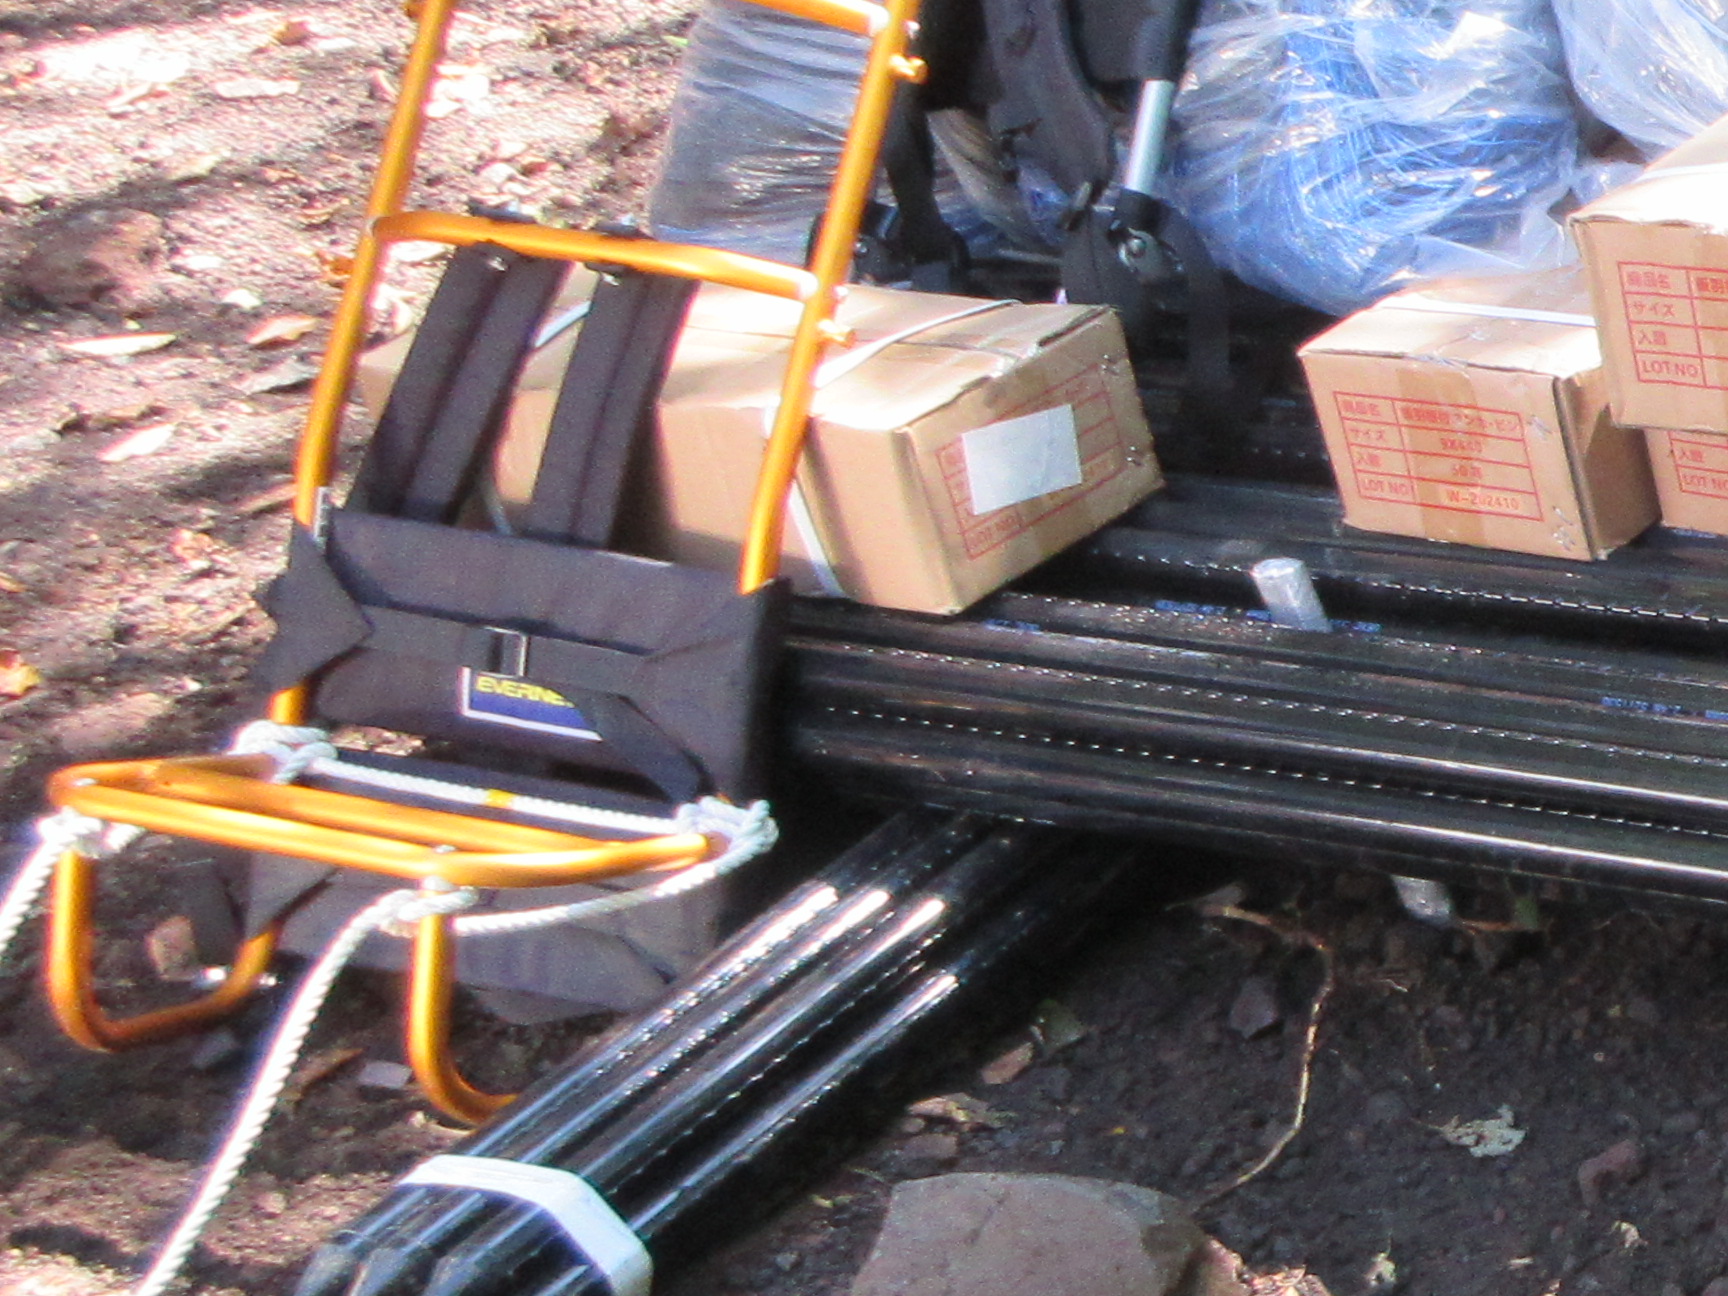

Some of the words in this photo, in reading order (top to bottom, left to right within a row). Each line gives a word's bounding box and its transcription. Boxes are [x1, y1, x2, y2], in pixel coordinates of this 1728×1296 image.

[1642, 361, 1671, 375] LOT
[1675, 364, 1698, 378] NO
[1362, 478, 1386, 493] LOT
[1388, 481, 1411, 496] NO
[1683, 474, 1709, 488] LOT
[475, 675, 576, 708] EVERNE
